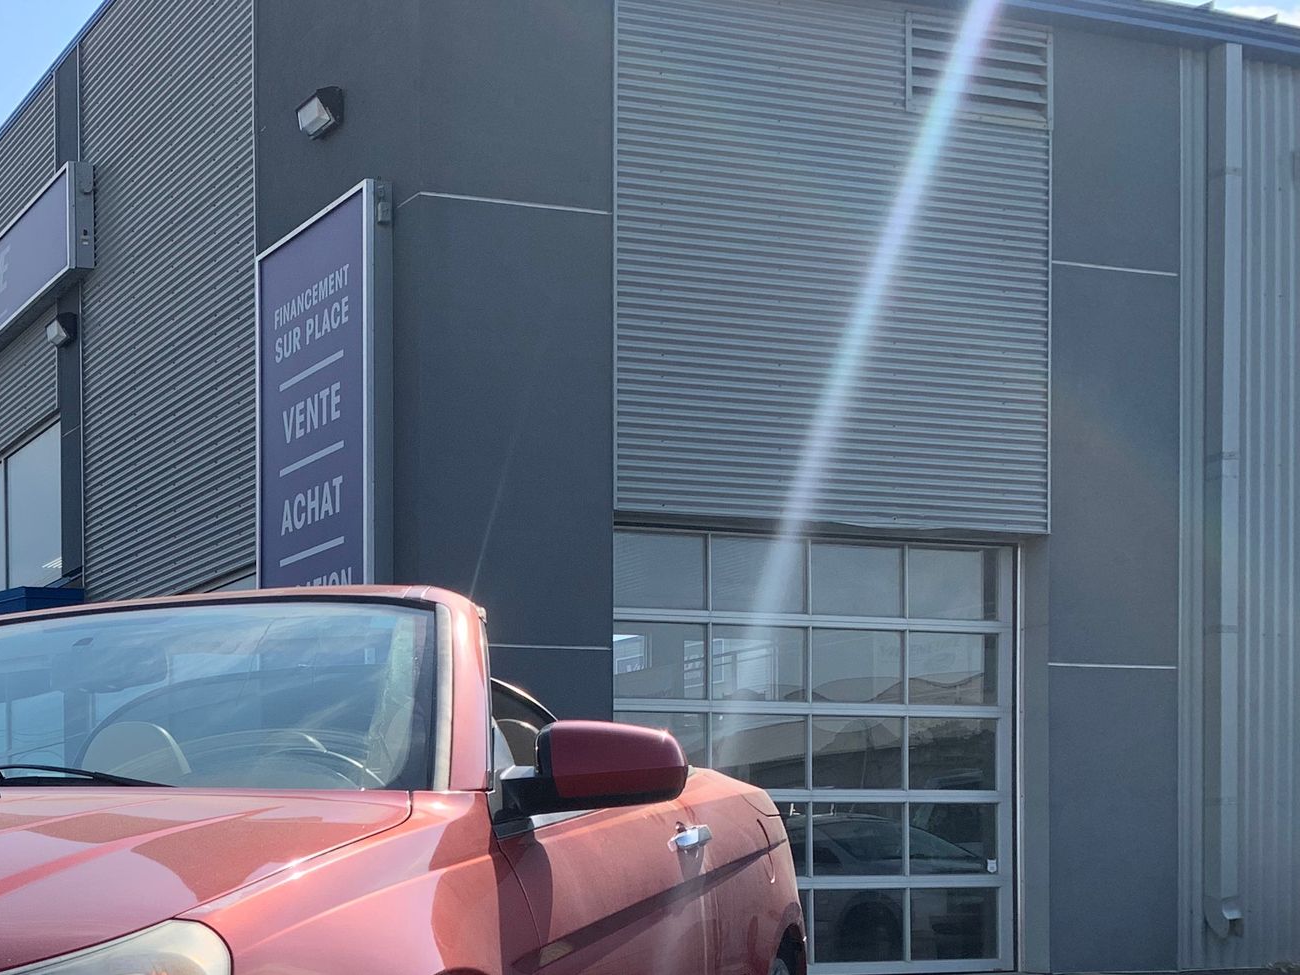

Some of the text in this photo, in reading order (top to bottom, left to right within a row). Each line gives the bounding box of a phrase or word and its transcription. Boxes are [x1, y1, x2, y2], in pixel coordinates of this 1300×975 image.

[274, 263, 350, 331] FINANCEMENT
[275, 295, 350, 364] SUR PLACE
[282, 381, 341, 444] VENTE
[280, 475, 343, 536] ACHAT
